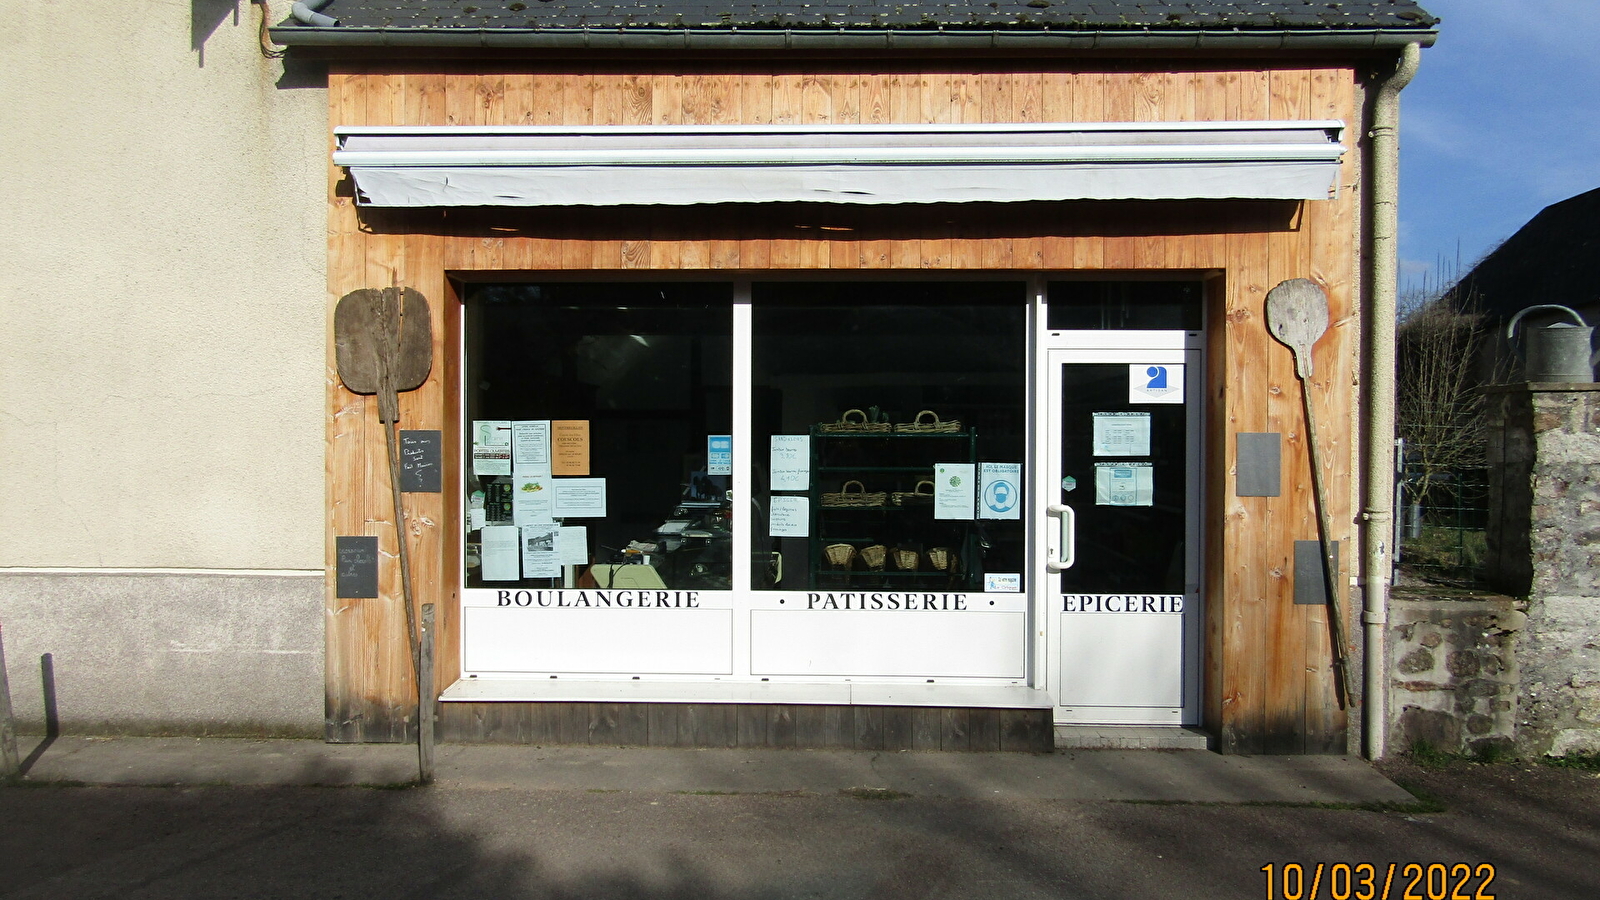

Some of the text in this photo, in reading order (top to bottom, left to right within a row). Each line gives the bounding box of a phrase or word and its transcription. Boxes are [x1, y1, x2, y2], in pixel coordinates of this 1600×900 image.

[497, 590, 700, 608] BOULANGERIE
[807, 593, 968, 611] PATISSERIE
[1062, 595, 1184, 612] EPICERIE
